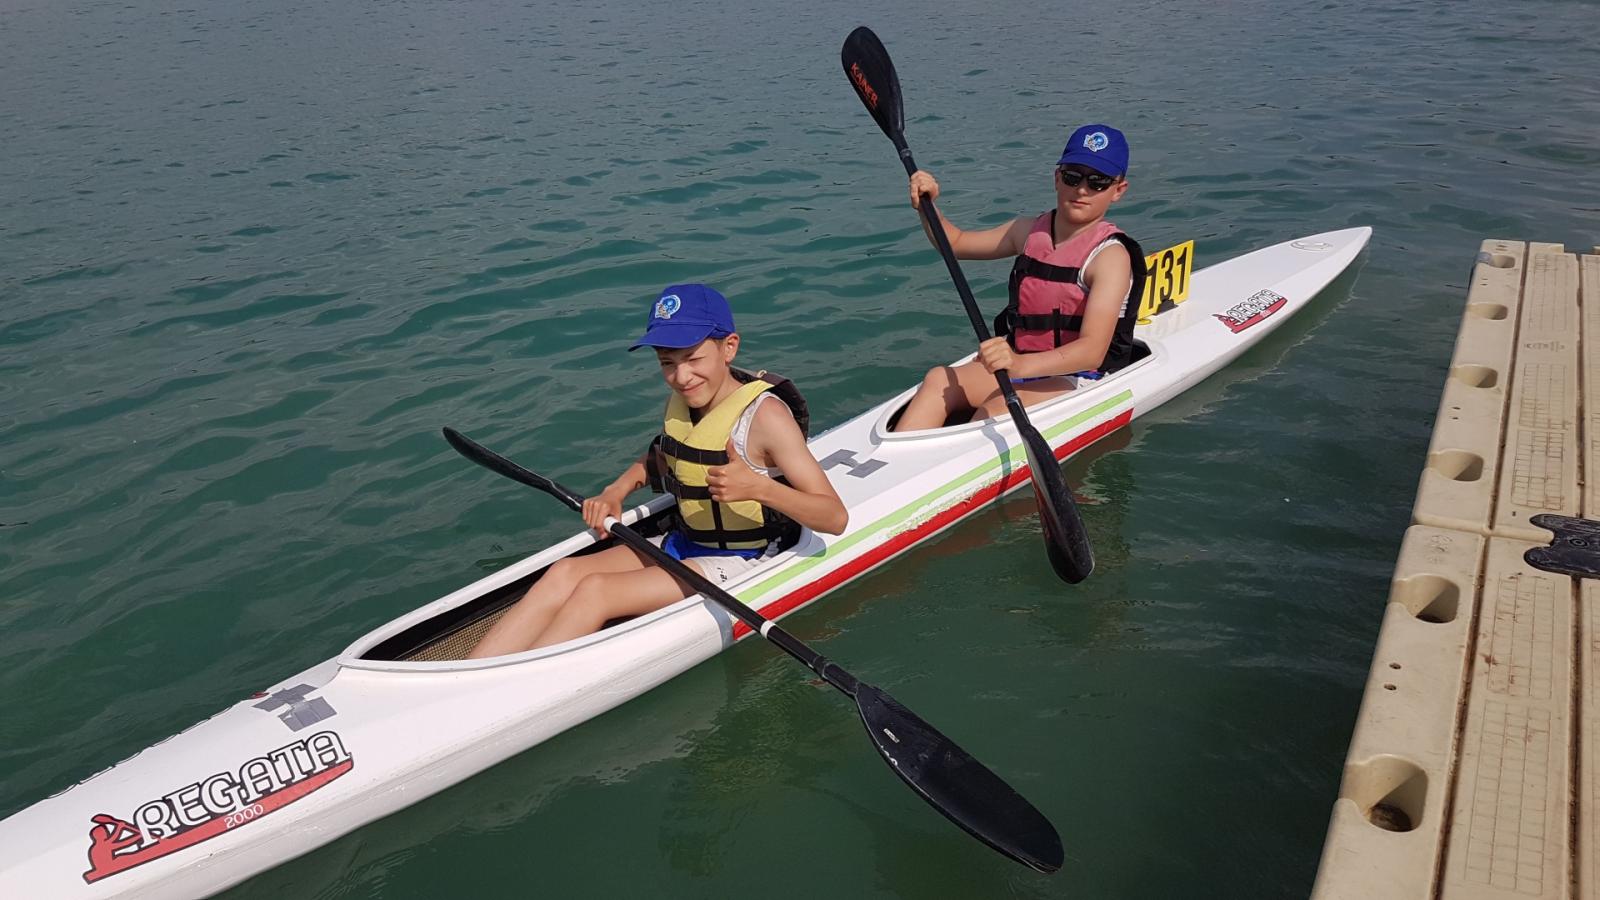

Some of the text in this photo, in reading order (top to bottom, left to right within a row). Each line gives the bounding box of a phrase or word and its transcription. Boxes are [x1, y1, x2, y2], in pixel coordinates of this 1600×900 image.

[1147, 246, 1188, 310] 131
[133, 730, 353, 848] REGATA
[224, 803, 264, 829] 2000
